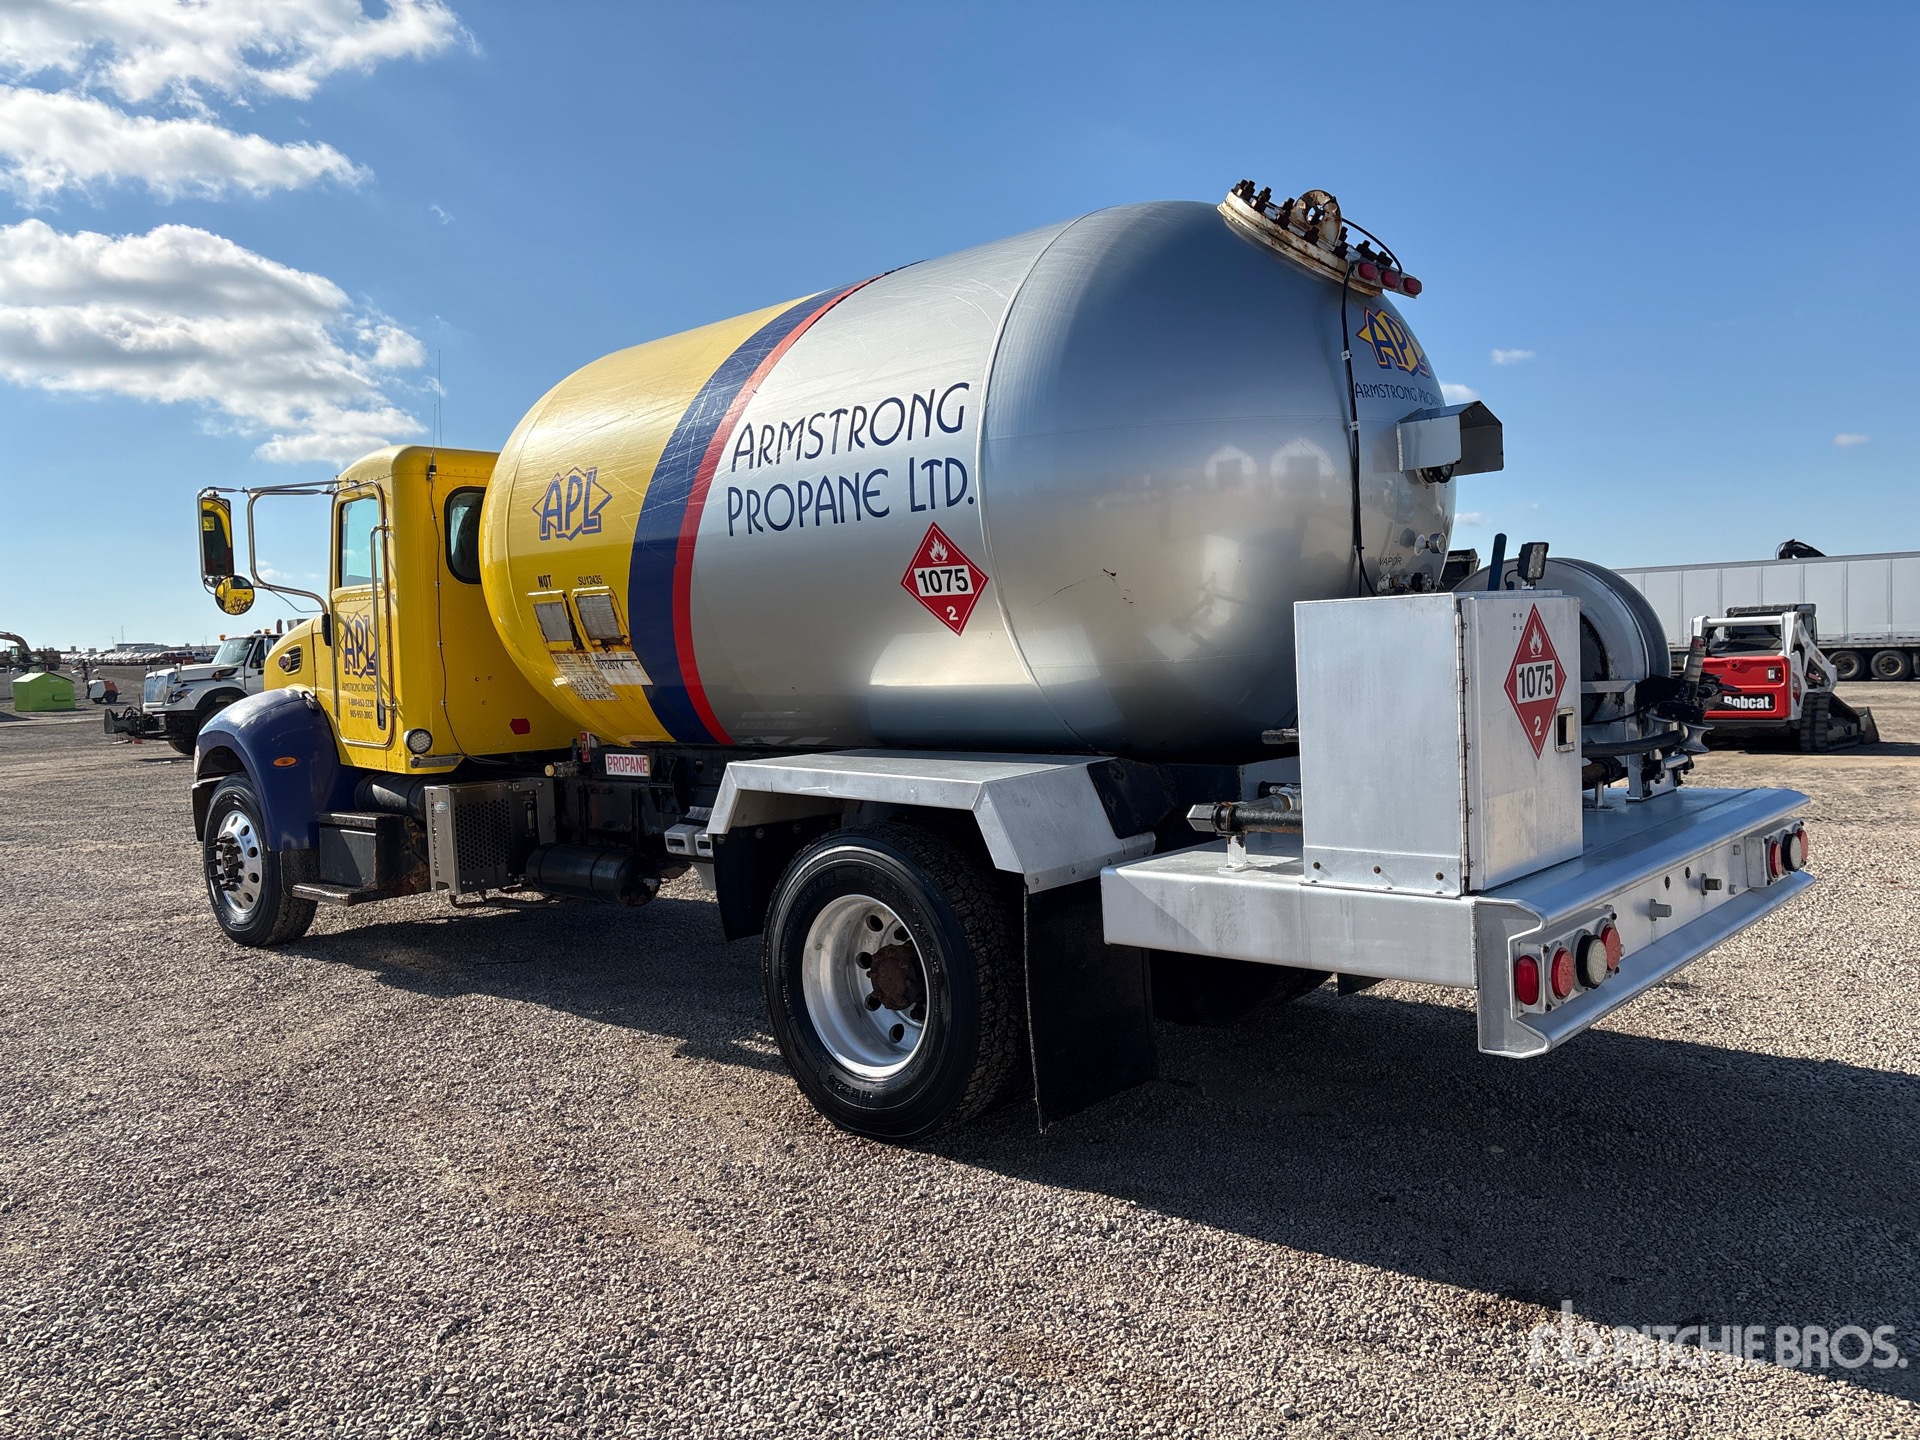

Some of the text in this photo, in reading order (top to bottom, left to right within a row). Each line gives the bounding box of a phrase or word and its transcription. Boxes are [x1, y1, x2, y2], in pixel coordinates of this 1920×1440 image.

[1360, 307, 1431, 379] APL
[1355, 382, 1417, 401] ARMSTRONG
[731, 382, 970, 472] ARMSTRONG
[539, 467, 602, 540] APL
[727, 456, 975, 537] PROPANE LTD.
[1379, 556, 1402, 566] VAPOR
[577, 575, 603, 586] SU12435
[917, 568, 969, 594] 1075
[946, 605, 958, 621] 2
[343, 614, 377, 676] APL
[1518, 663, 1554, 699] 1075
[1723, 695, 1770, 710] Bobcat
[1534, 715, 1542, 737] 2
[606, 755, 649, 774] PROPANE
